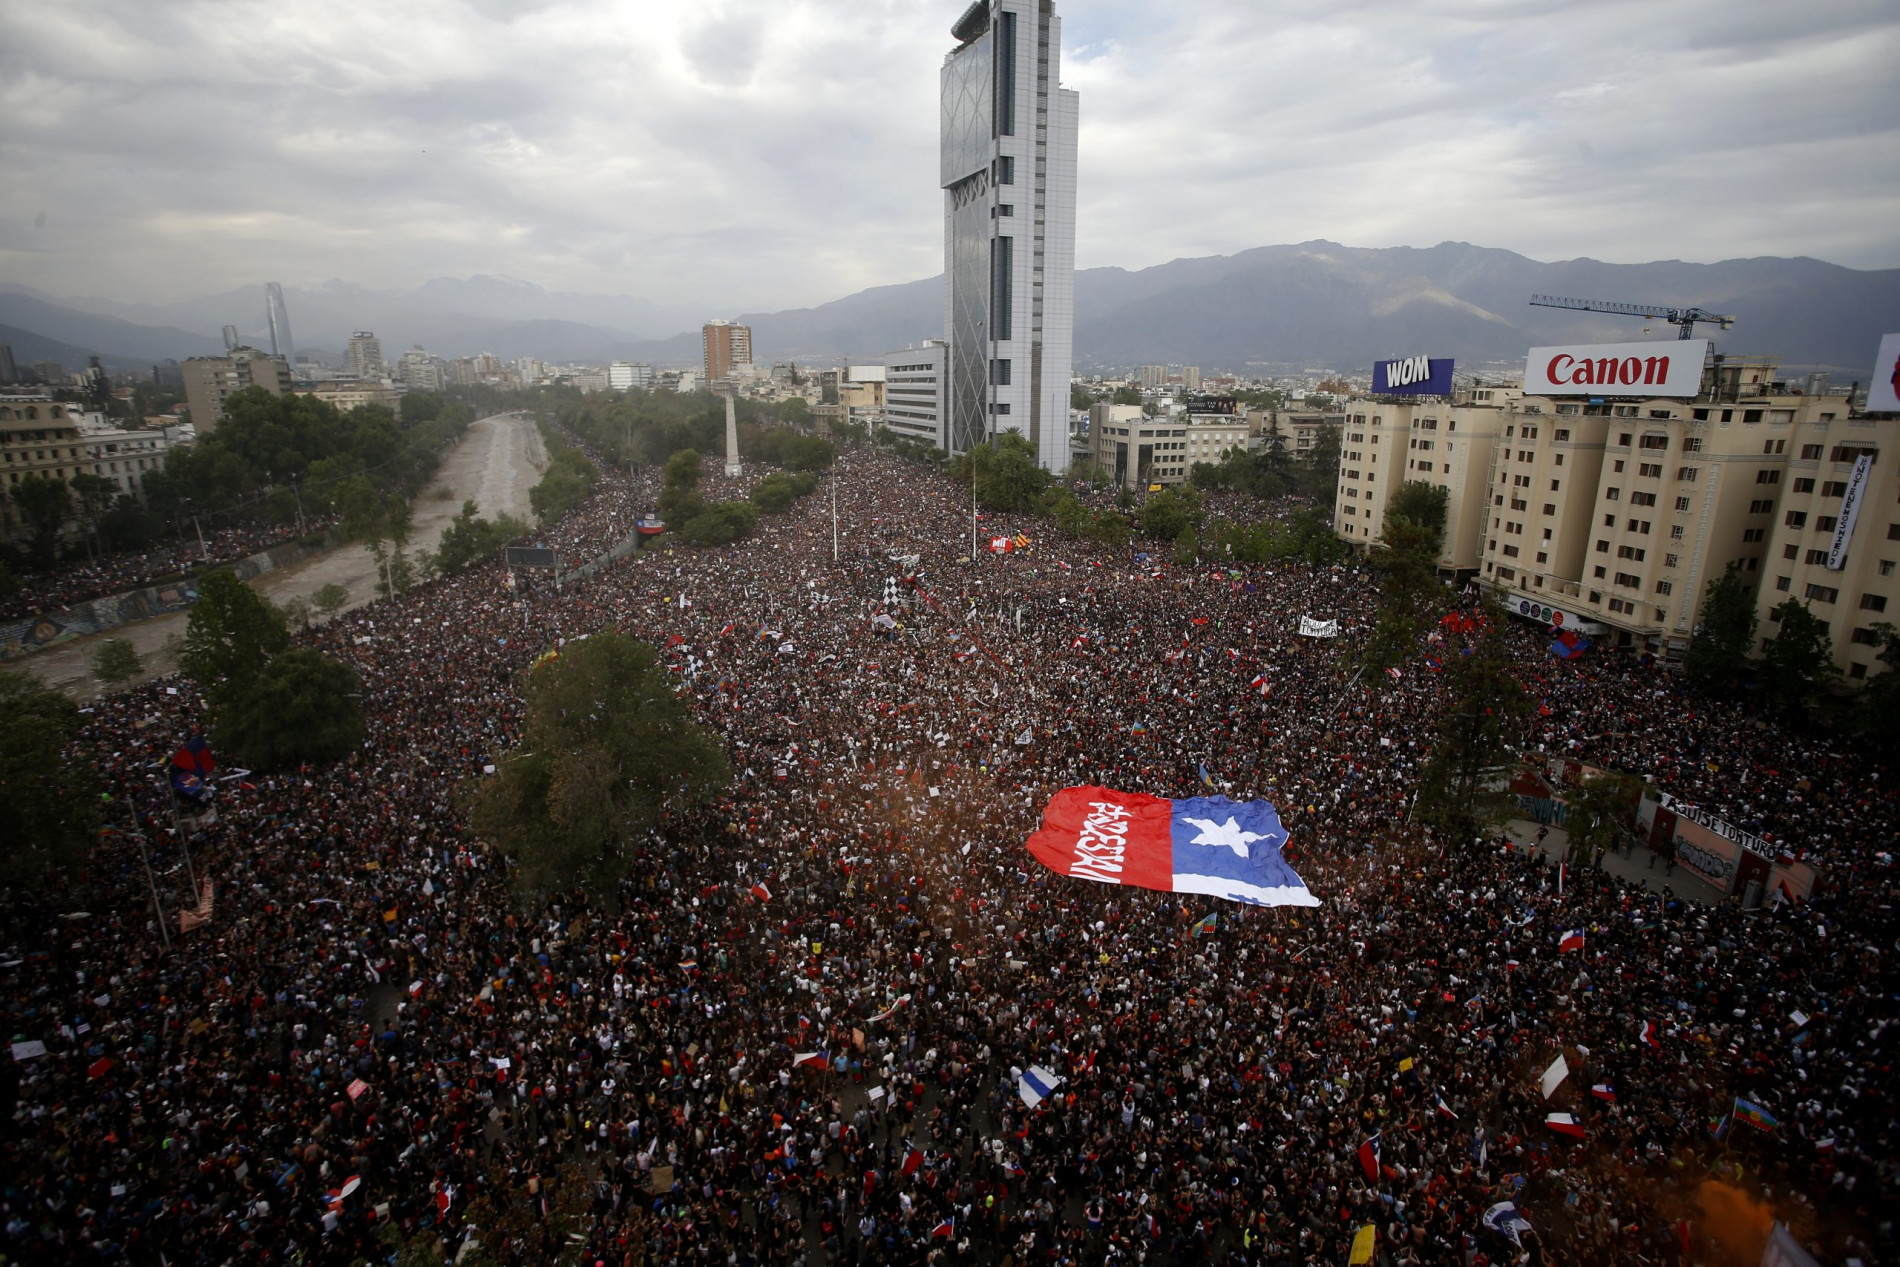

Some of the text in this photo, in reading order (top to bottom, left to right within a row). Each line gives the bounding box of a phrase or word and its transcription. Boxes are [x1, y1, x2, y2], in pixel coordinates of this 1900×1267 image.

[1387, 354, 1430, 388] WOM
[1547, 353, 1670, 386] Canon
[992, 537, 1009, 548] MIT
